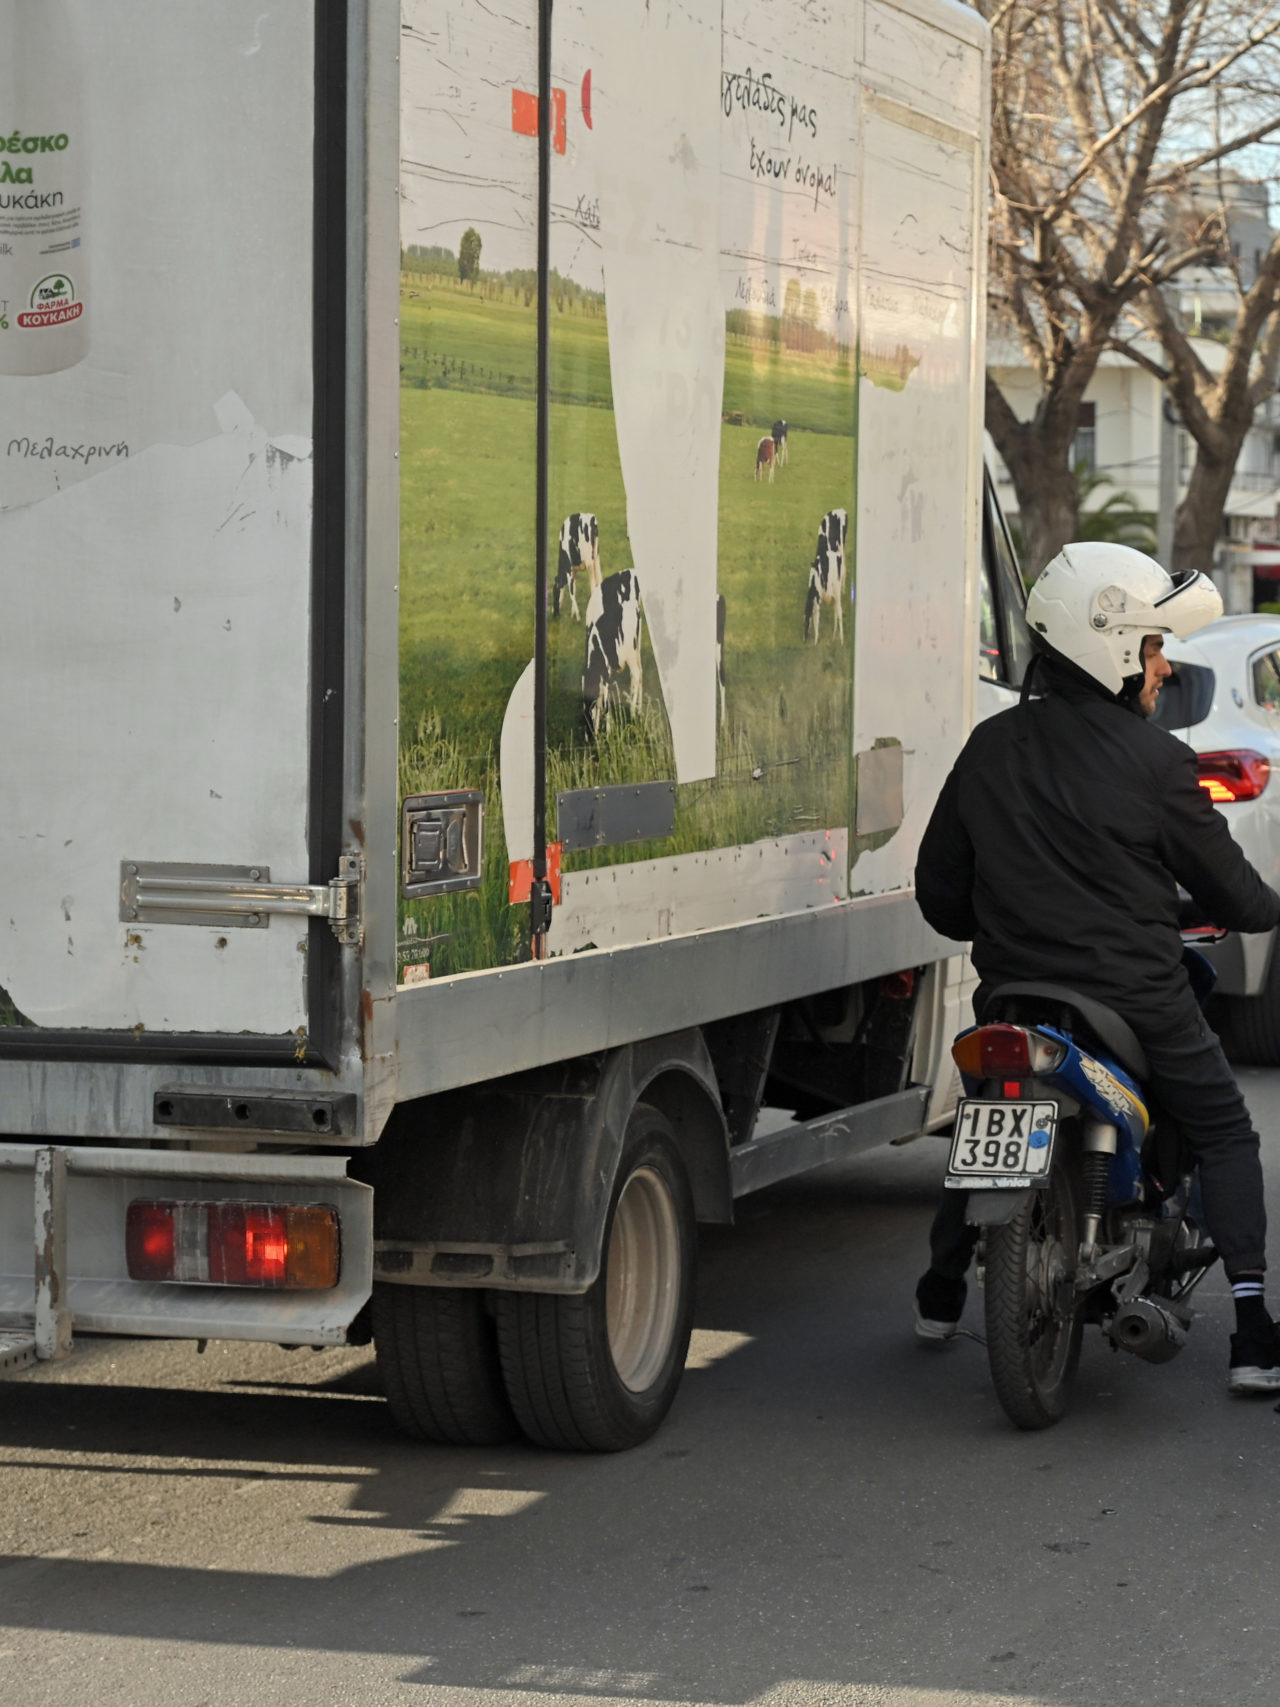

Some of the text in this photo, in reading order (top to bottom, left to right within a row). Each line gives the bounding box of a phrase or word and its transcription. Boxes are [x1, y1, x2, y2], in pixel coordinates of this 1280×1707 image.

[788, 95, 817, 143] μας
[0, 161, 33, 184] λα
[23, 305, 80, 325] ΚΟΥΚΑΚΗ
[36, 298, 70, 310] ΦΑΡΜΑ
[961, 1140, 1022, 1168] 398
